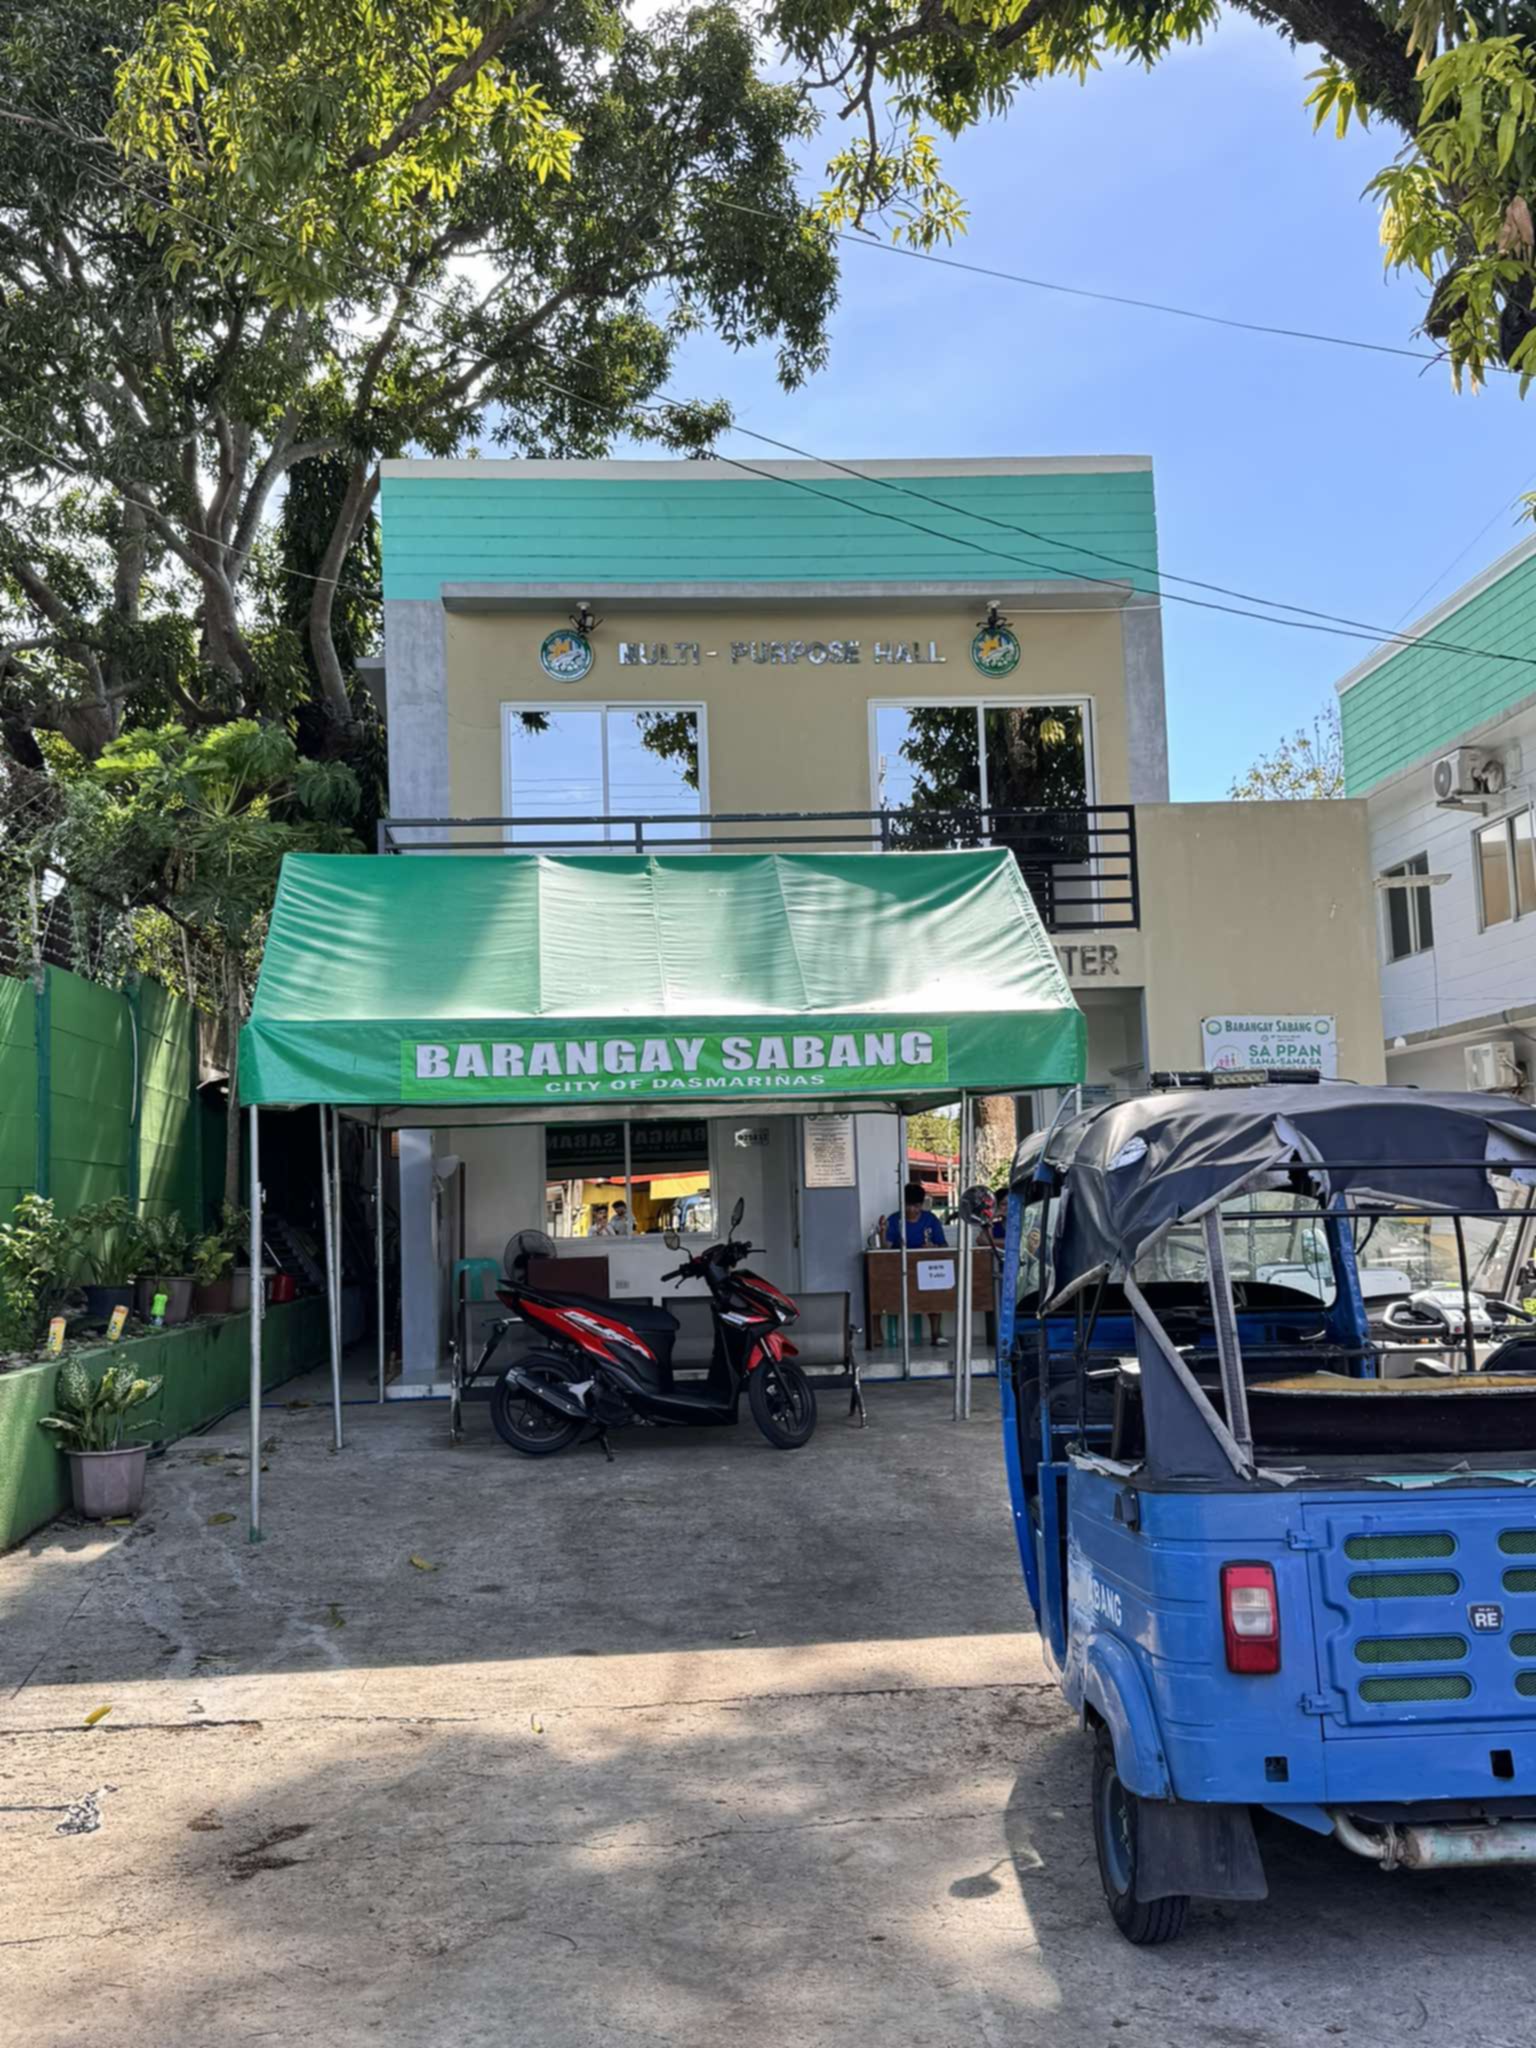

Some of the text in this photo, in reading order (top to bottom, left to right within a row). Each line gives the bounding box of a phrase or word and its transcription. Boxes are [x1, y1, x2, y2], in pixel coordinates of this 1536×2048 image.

[619, 641, 700, 666] MULTI
[730, 640, 860, 665] PURPOSE
[874, 640, 947, 664] HALL
[1053, 945, 1120, 977] TER
[1225, 1020, 1312, 1032] BARANGAY SABANG
[416, 1030, 934, 1078] BARANGAY SABANG
[1249, 1044, 1321, 1057] SA PPAN
[546, 1081, 601, 1093] CITY
[610, 1079, 642, 1090] OF
[1474, 1613, 1499, 1627] RE
